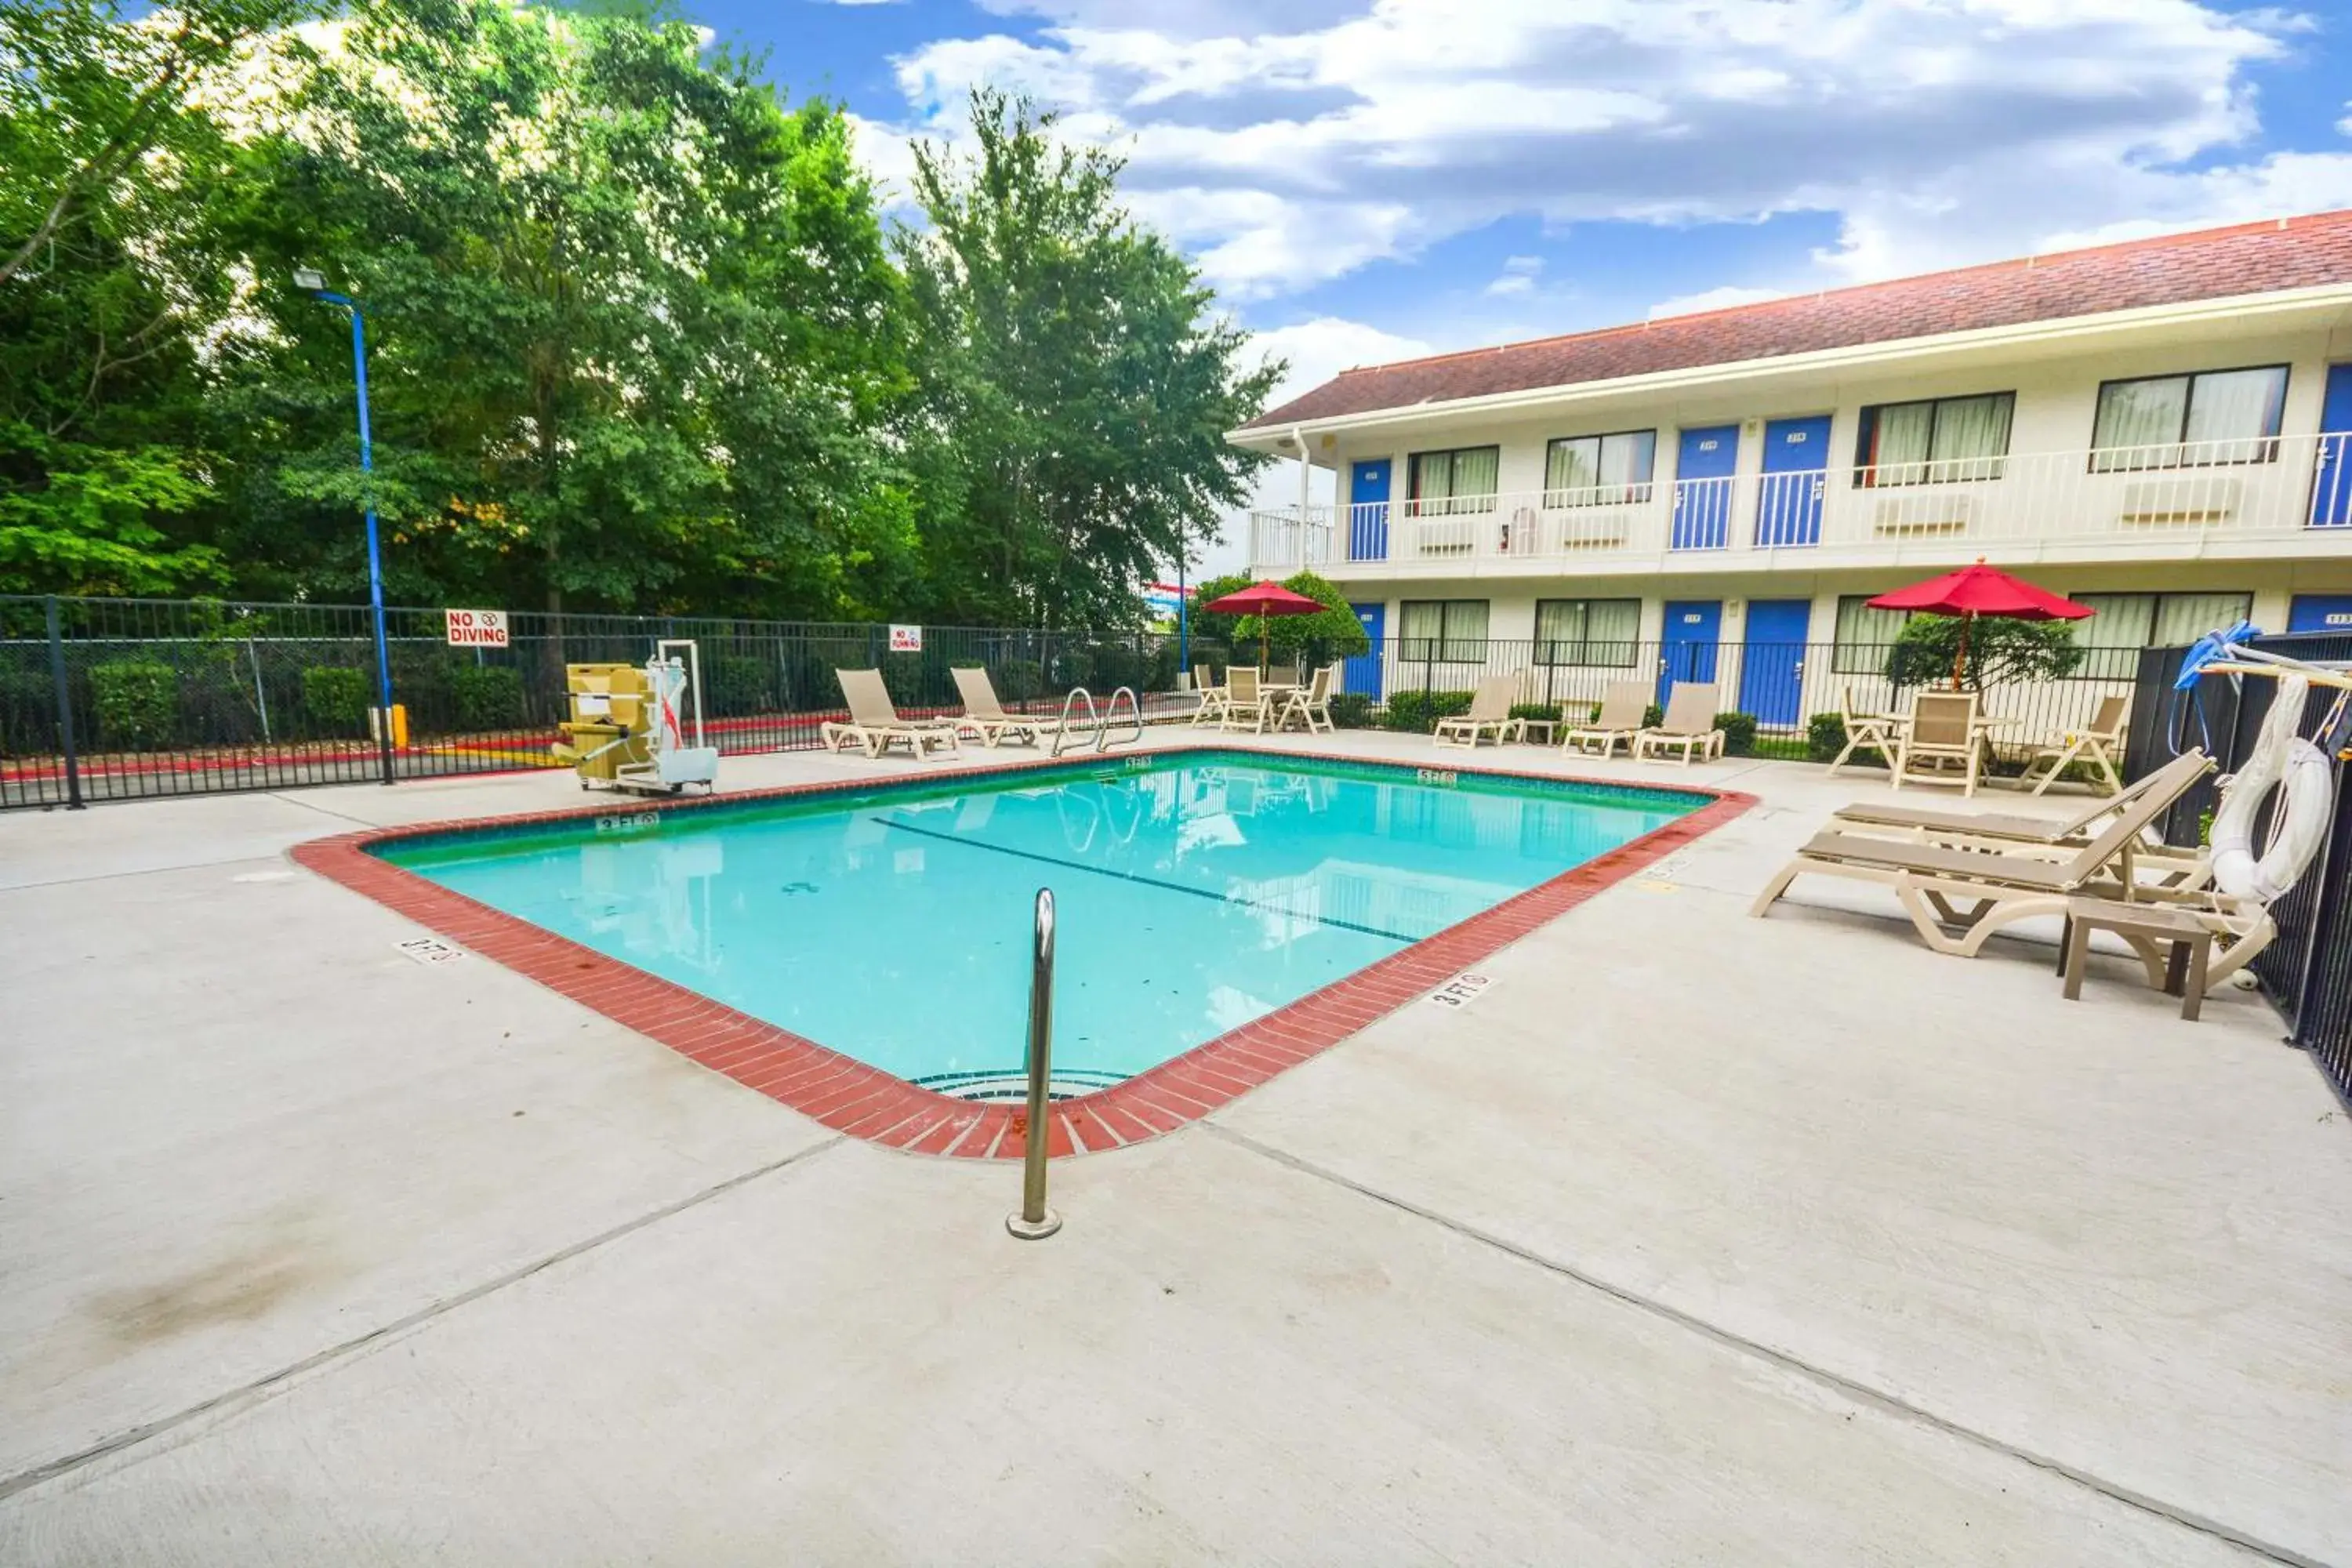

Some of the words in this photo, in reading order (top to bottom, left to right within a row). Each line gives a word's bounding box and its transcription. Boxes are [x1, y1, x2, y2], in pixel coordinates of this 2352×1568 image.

[450, 613, 473, 626] NO
[452, 628, 506, 642] DIVING
[896, 630, 906, 639] NO
[1432, 995, 1461, 1005] 3
